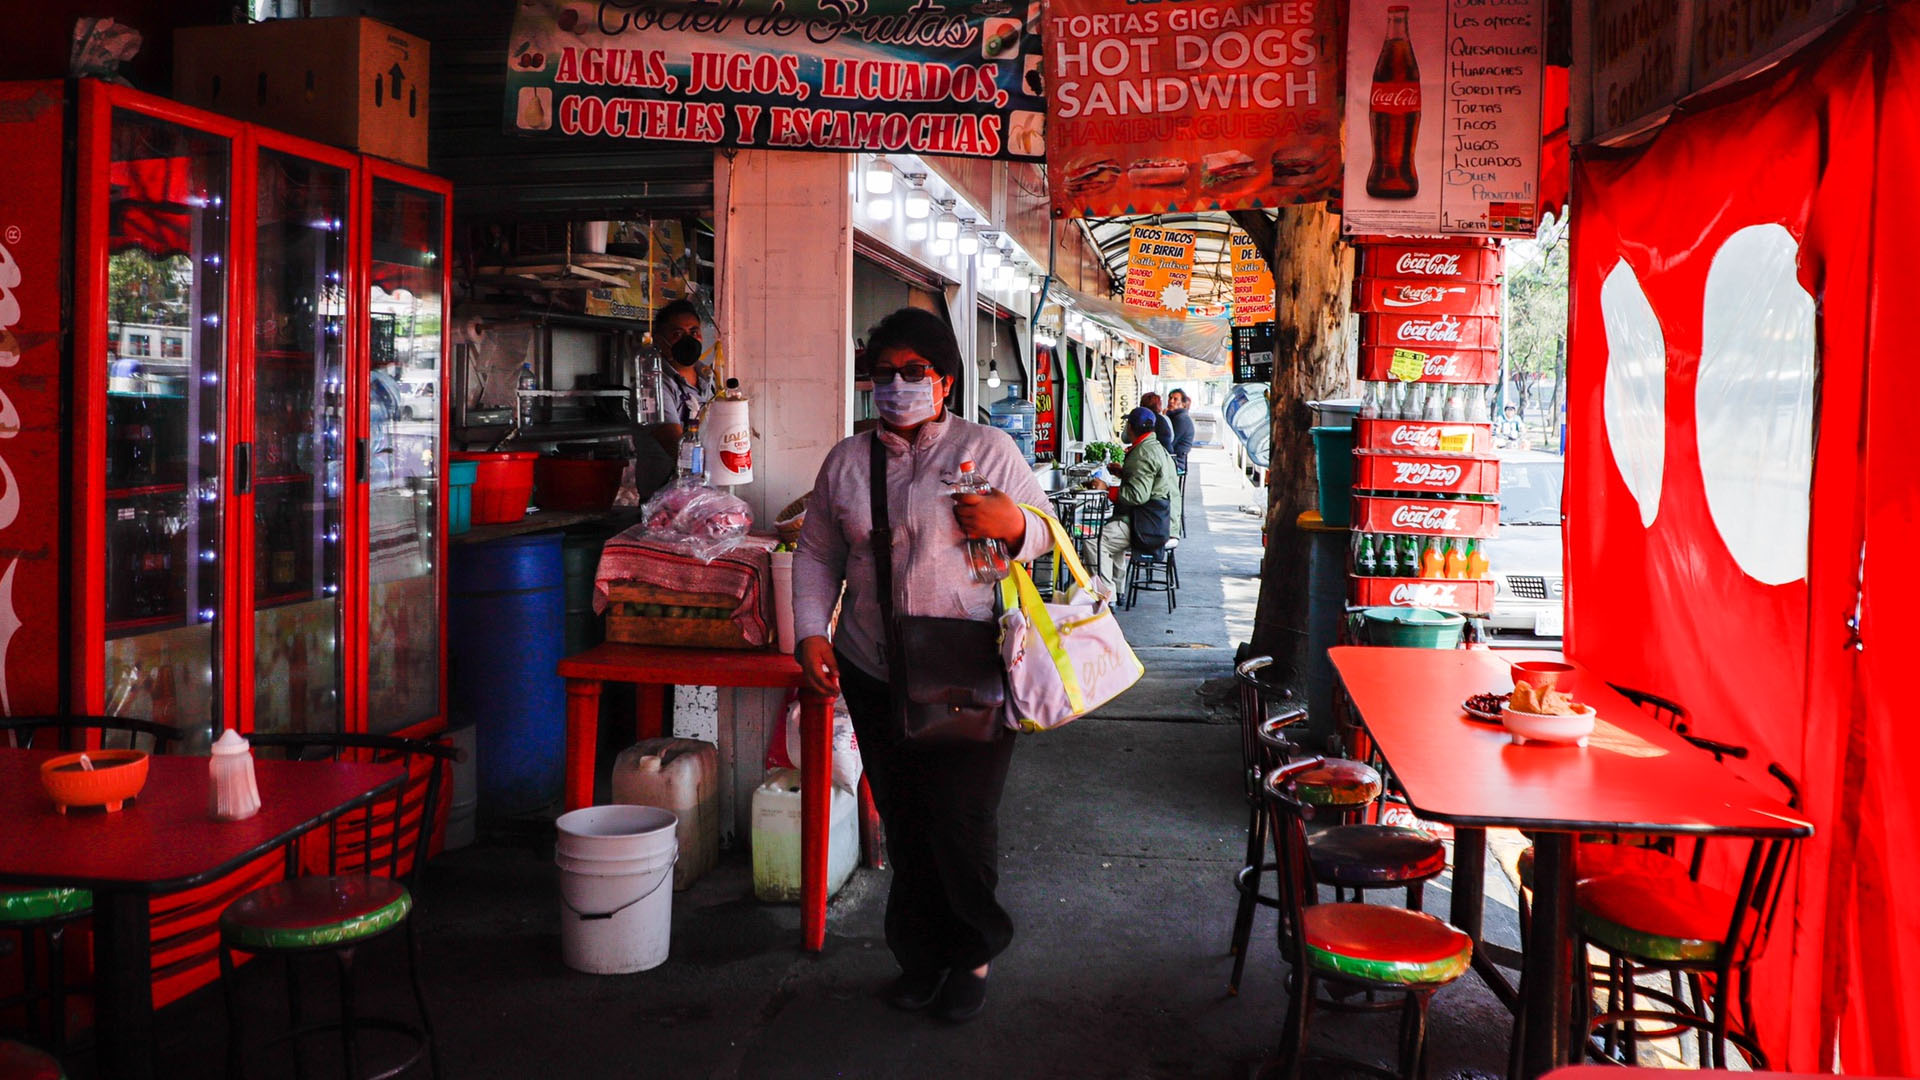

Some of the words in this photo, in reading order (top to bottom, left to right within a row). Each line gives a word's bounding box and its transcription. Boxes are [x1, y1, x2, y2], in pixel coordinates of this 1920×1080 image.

[745, 1, 800, 37] de
[806, 0, 979, 48] Frutas
[1053, 11, 1160, 38] TORTAS
[1168, 2, 1315, 31] GIGANTES
[1454, 12, 1479, 29] Les
[1057, 37, 1159, 77] HOT
[1176, 28, 1316, 71] DOGS
[554, 47, 678, 94] AGUAS,
[687, 52, 808, 100] JUGOS,
[822, 58, 1009, 107] LICUADOS,
[1056, 70, 1318, 118] SANDWICH
[560, 95, 726, 143] COCTELES
[737, 106, 762, 145] Y
[766, 108, 1001, 156] ESCAMOCHAS
[1057, 110, 1320, 147] HAMBURGUESAS
[1443, 211, 1453, 228] 1
[1133, 228, 1162, 240] RICOS
[1164, 231, 1193, 244] TACOS
[1233, 235, 1254, 245] RICO
[1139, 243, 1152, 254] DE
[1153, 245, 1184, 258] BIRRIA
[1241, 249, 1253, 260] DE
[1396, 253, 1461, 275] Coca-Cola
[1128, 268, 1153, 278] SUADERO
[1234, 275, 1258, 284] SUADERO
[1126, 287, 1156, 298] LONGANIZA
[1235, 295, 1265, 303] LONGANIZA
[1125, 297, 1161, 308] CAMPECHANO
[1236, 304, 1272, 313] CAMPECHANO
[1397, 319, 1462, 342] Coca-Cola
